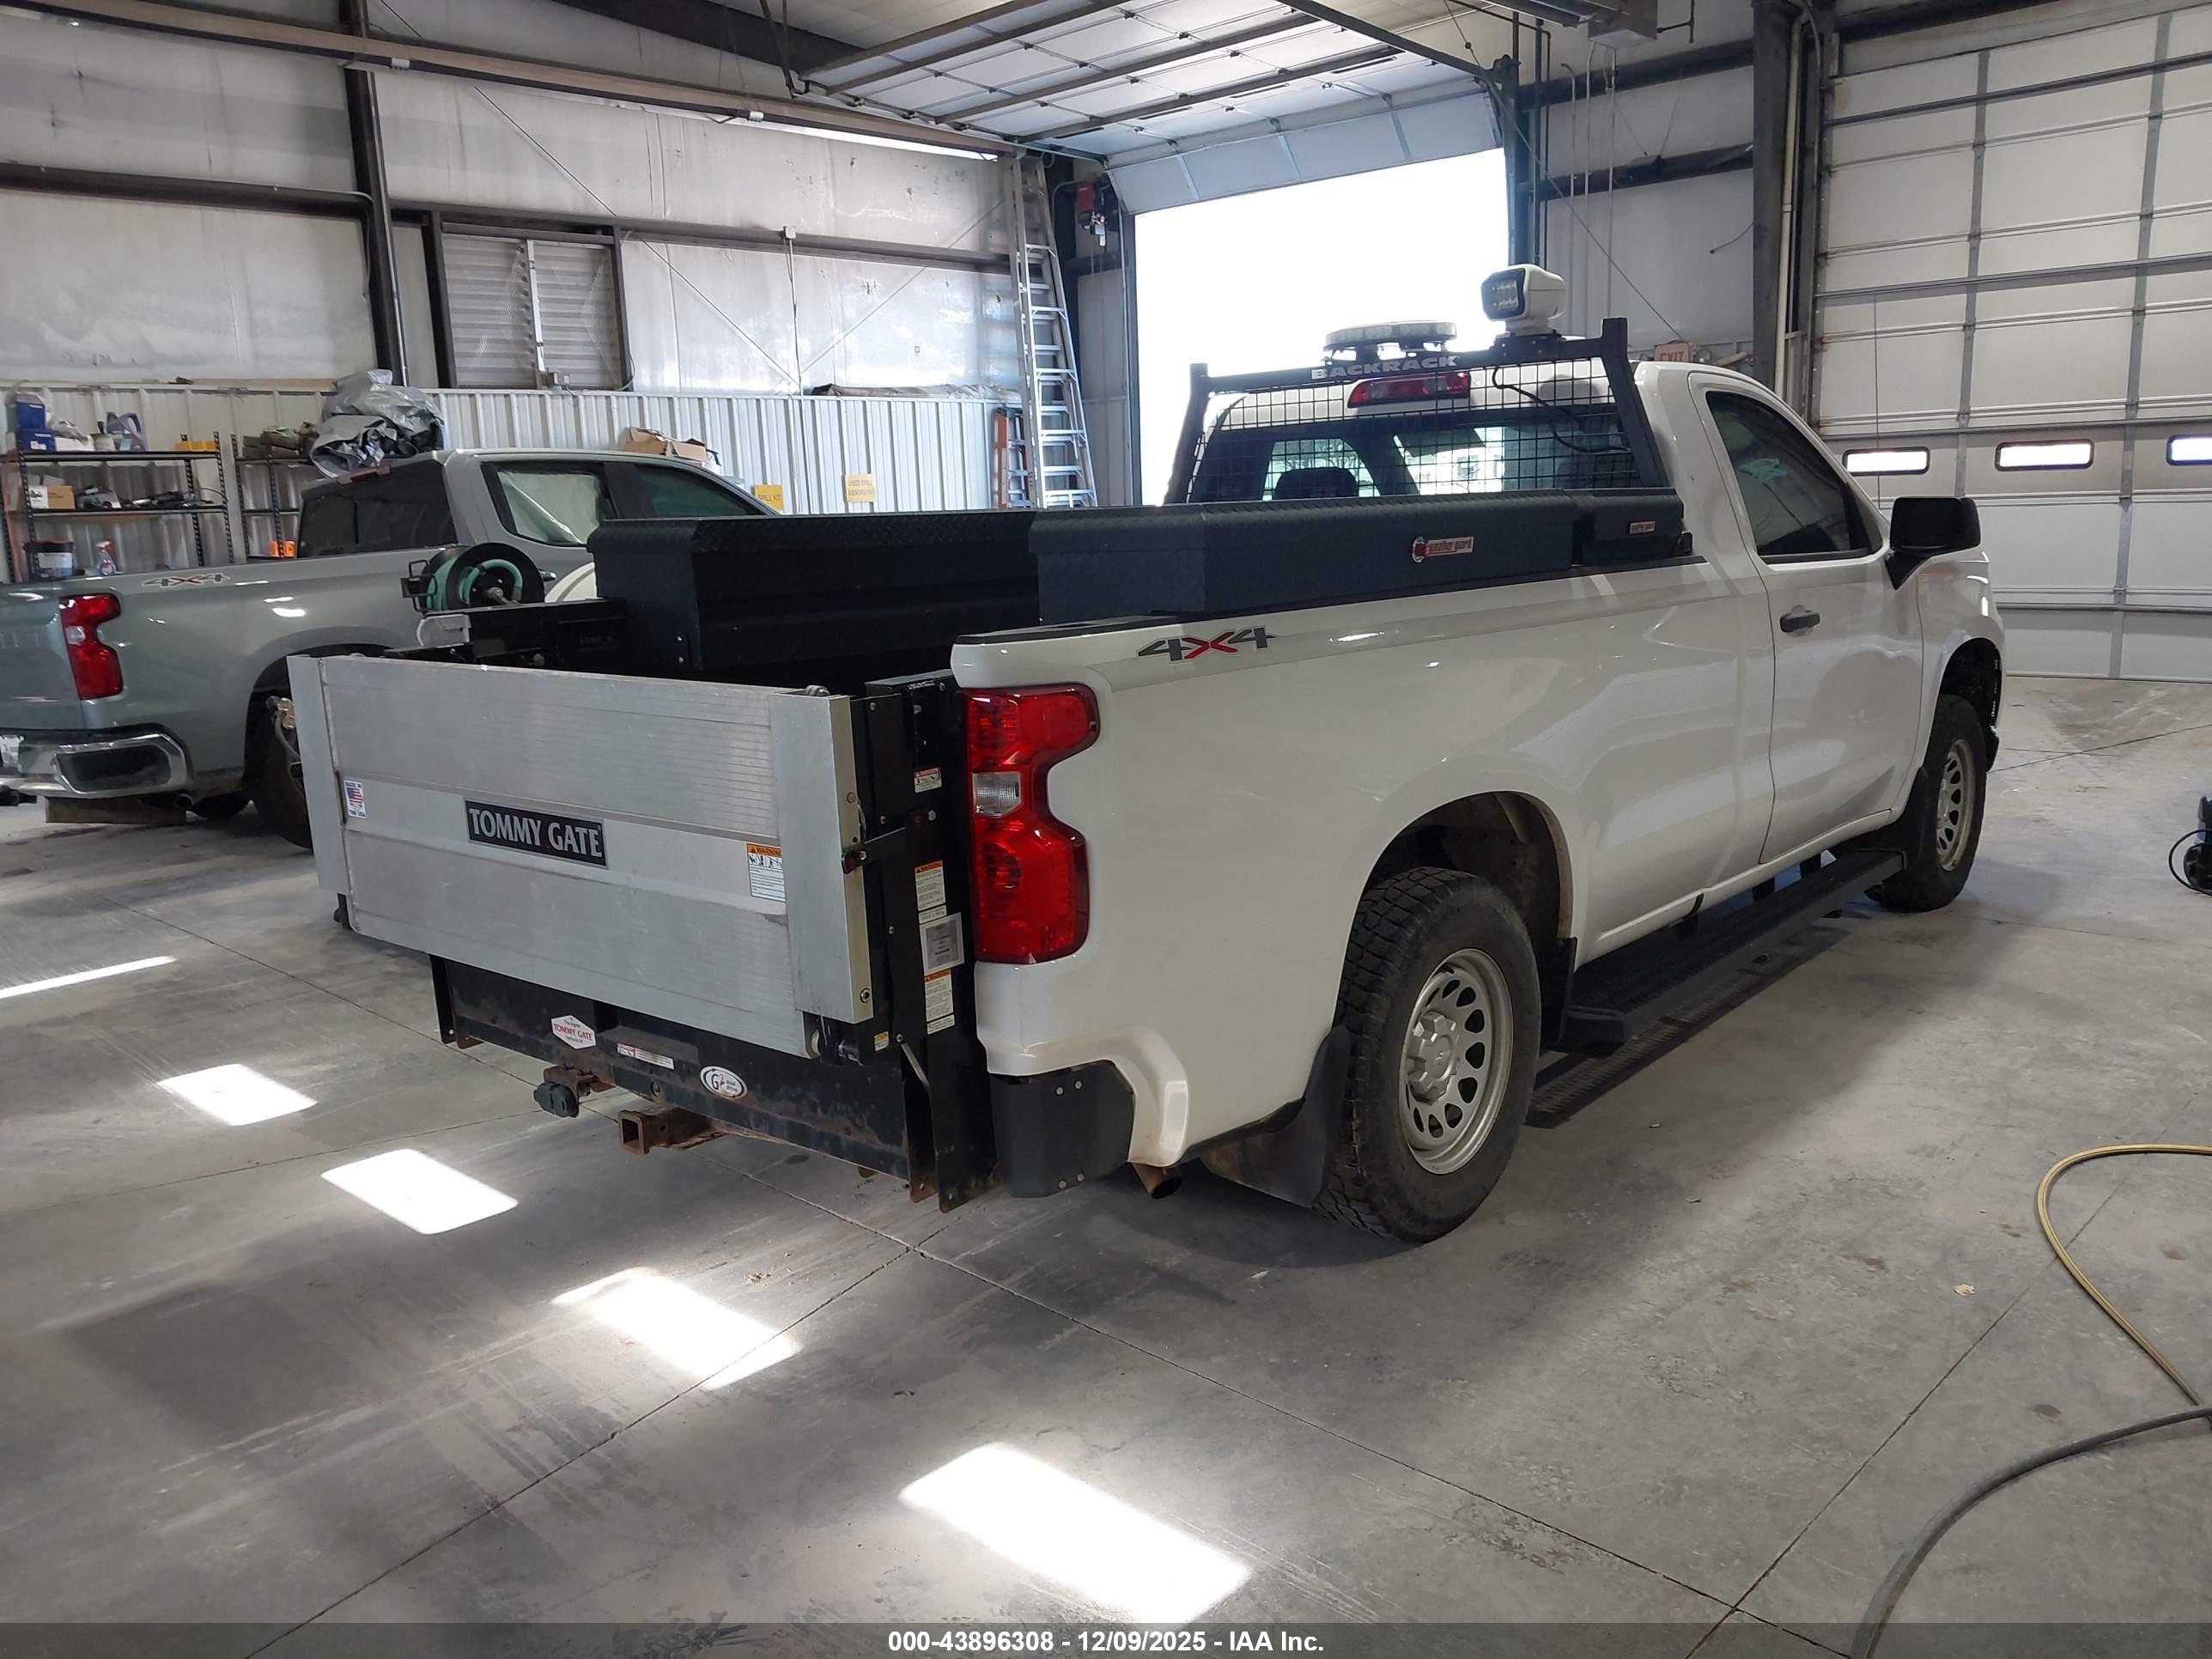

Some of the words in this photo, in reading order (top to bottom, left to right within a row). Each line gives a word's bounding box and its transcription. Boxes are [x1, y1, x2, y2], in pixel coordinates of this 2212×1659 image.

[1311, 356, 1457, 380] BACKRACK
[469, 808, 542, 847] TOMMY
[548, 822, 603, 858] GATE
[554, 1024, 575, 1036] TOMMY
[577, 1030, 592, 1040] GATE
